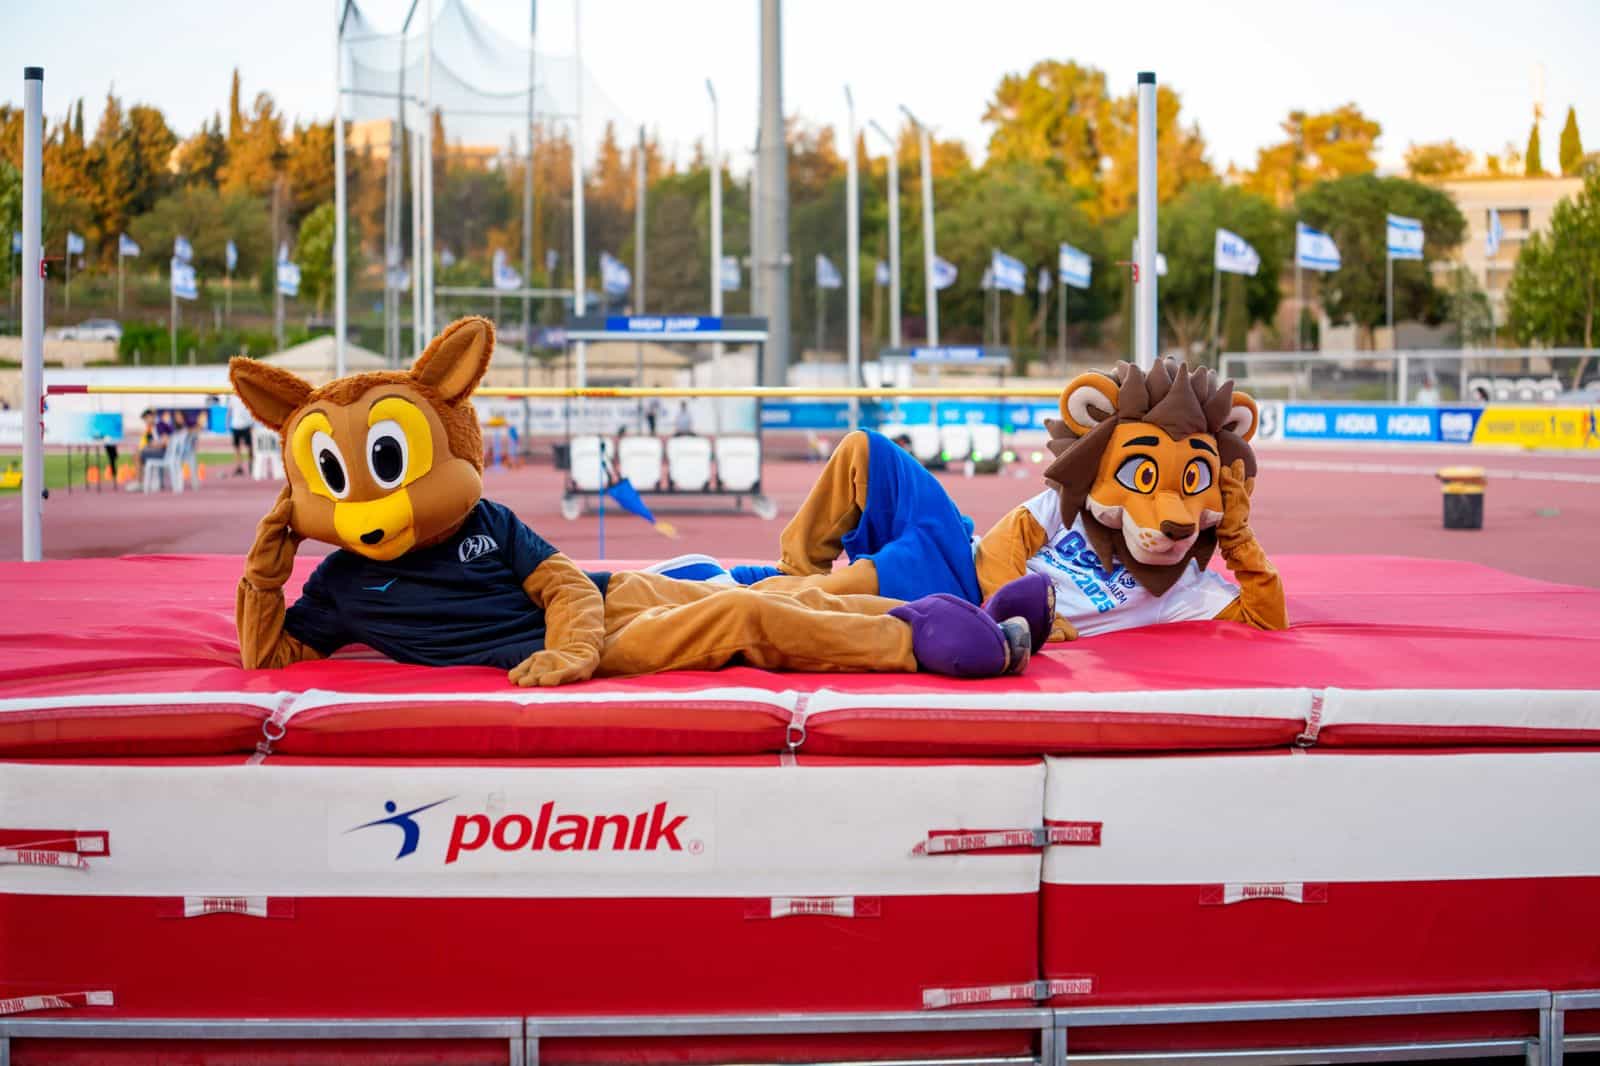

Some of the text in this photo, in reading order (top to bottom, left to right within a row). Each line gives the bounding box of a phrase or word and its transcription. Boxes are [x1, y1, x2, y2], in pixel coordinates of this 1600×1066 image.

[664, 317, 701, 330] JUMP
[444, 800, 688, 864] polanik
[17, 849, 60, 865] POLANIK
